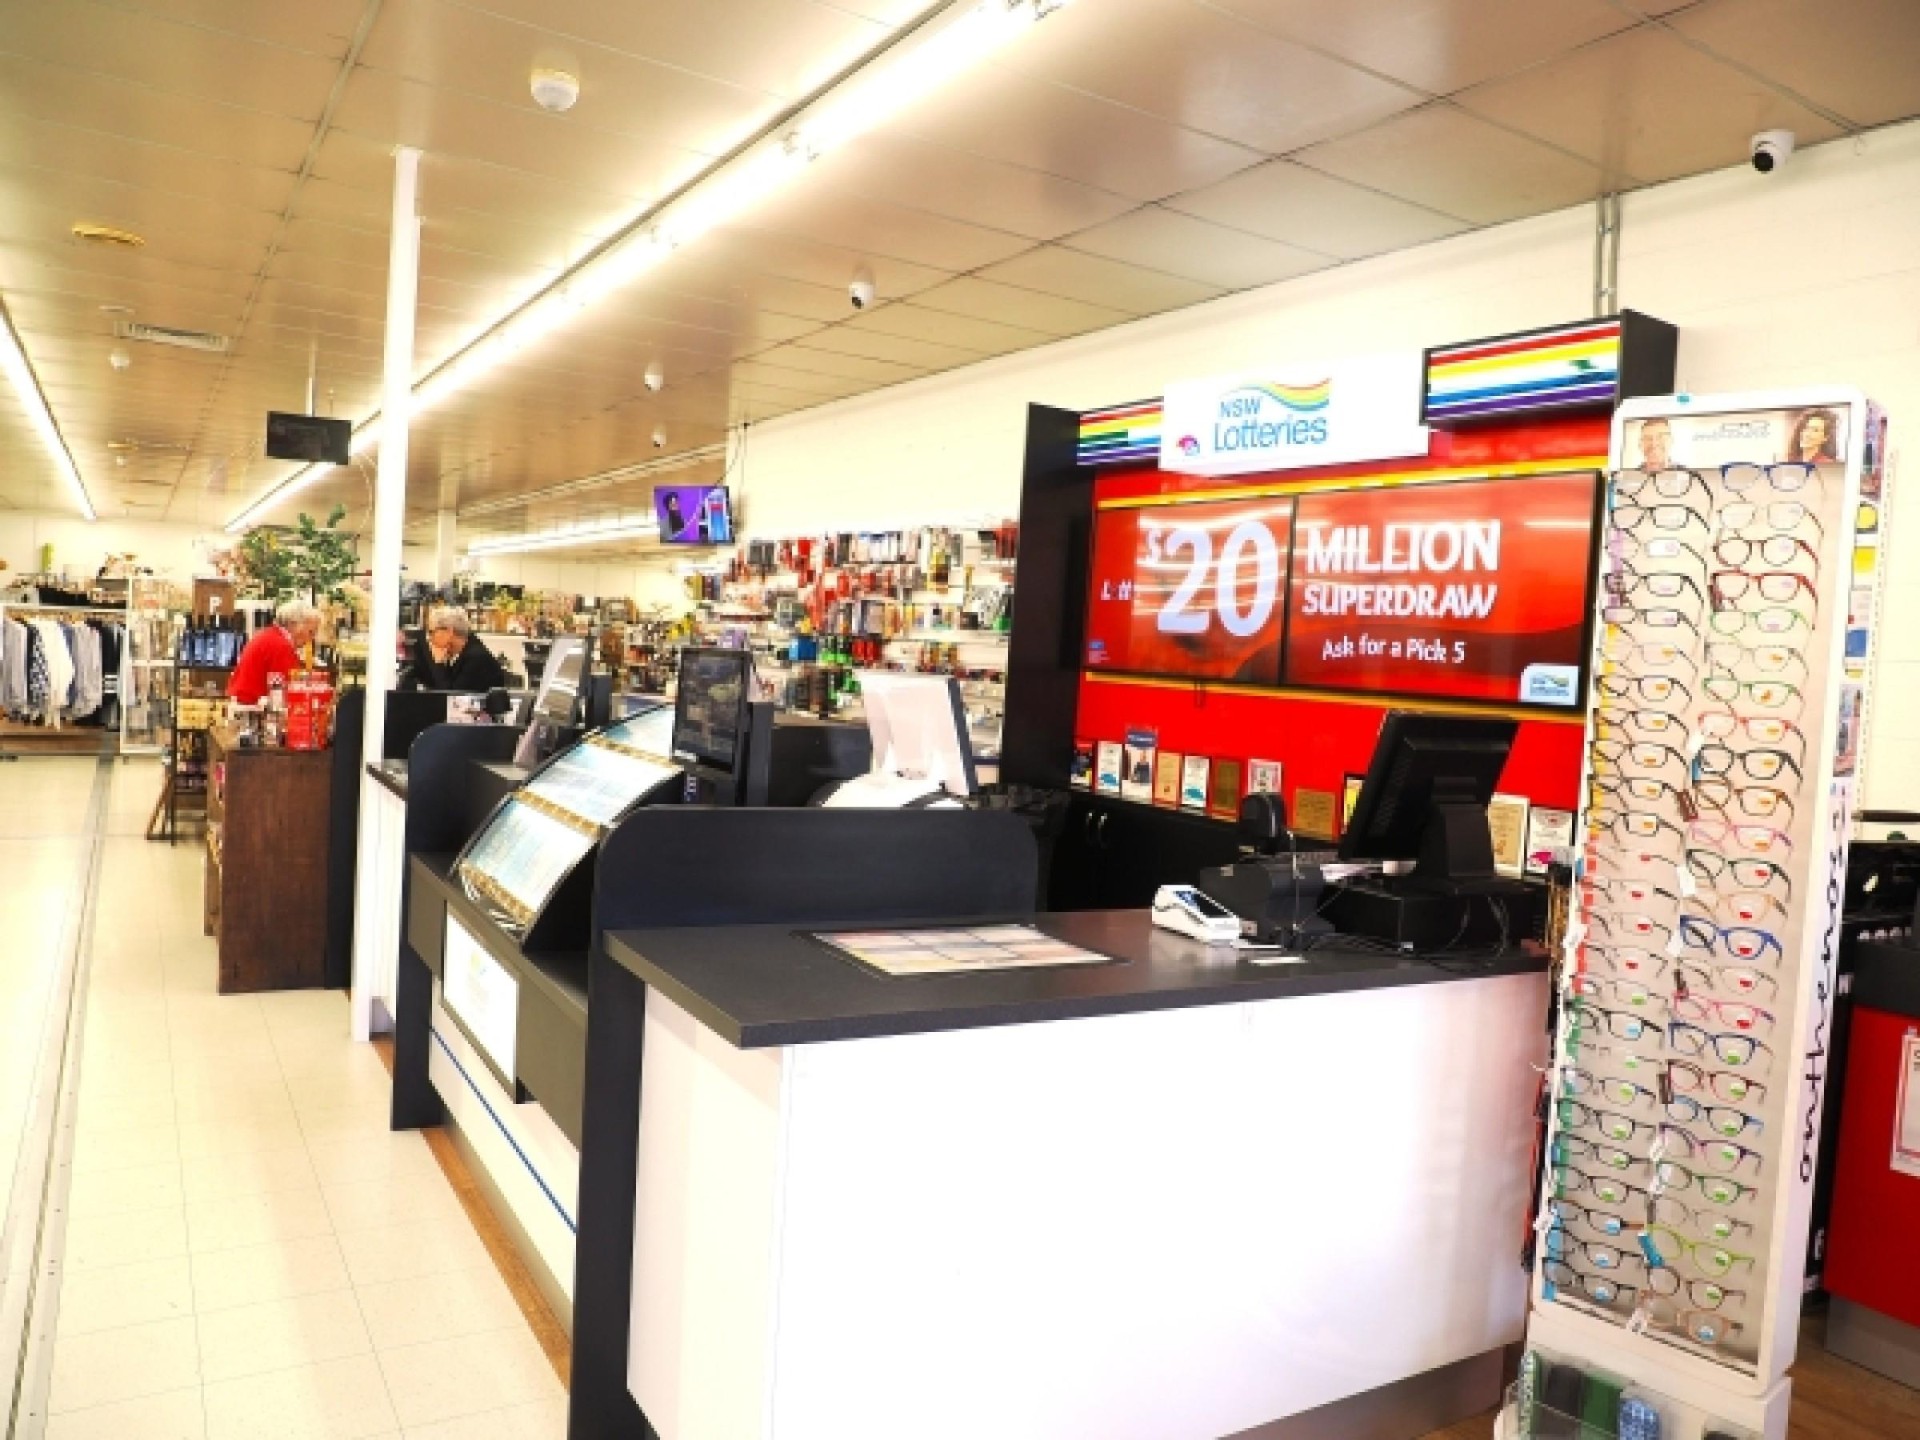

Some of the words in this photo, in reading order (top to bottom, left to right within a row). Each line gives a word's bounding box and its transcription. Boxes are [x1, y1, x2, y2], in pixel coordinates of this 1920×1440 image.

[1219, 398, 1262, 418] NSW
[1214, 414, 1328, 452] Lotteries
[1302, 582, 1498, 619] SUPERDRAW
[1322, 635, 1354, 661] Ask
[1359, 632, 1387, 656] for
[1390, 640, 1402, 658] a
[1406, 638, 1447, 663] Pick
[1452, 640, 1467, 664] 5
